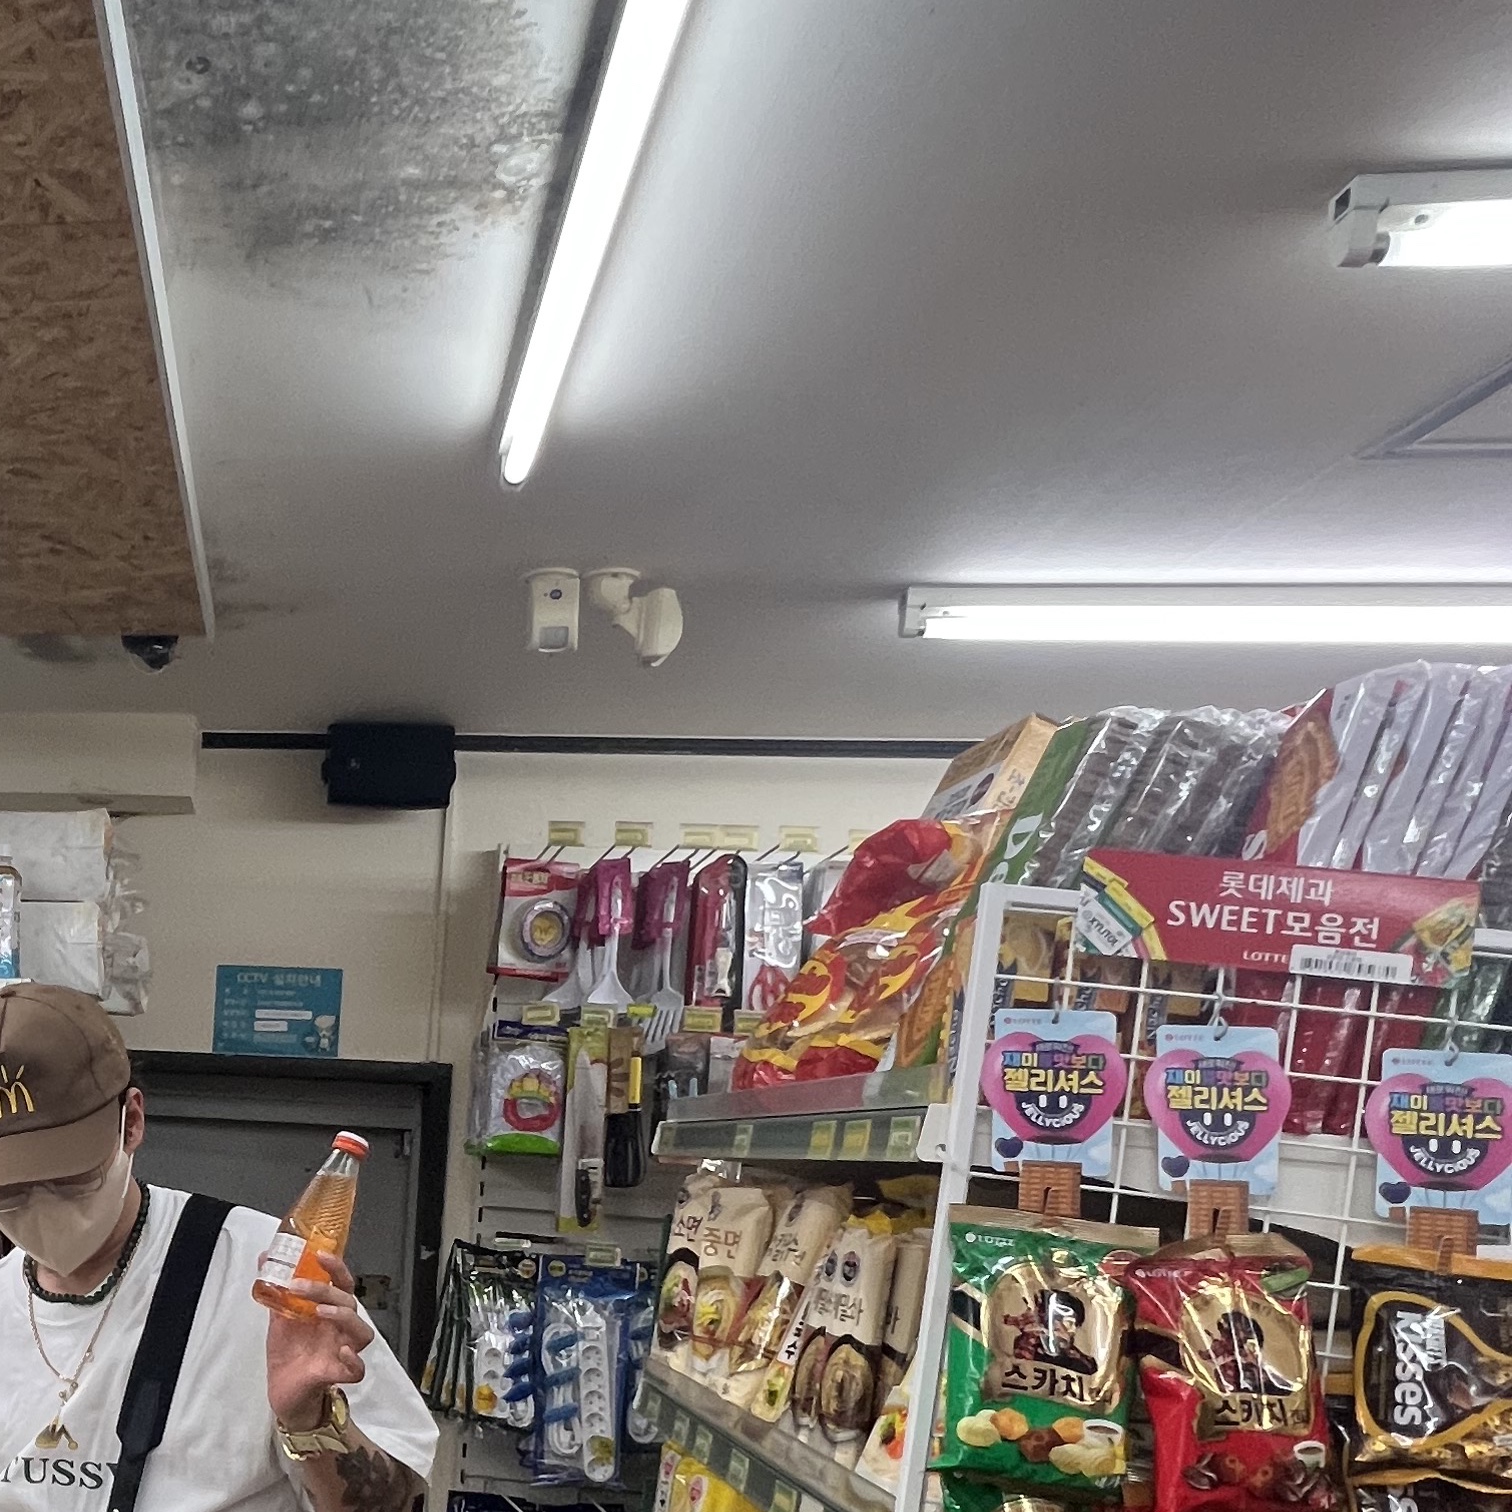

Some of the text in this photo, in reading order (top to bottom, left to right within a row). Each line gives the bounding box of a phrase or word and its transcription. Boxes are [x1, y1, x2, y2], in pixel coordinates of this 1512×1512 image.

[1219, 870, 1335, 907] 롯데제과
[1003, 1067, 1104, 1095] 젤리셔스
[1167, 1085, 1268, 1112] 젤리셔스
[1021, 1102, 1085, 1129] JELLYCIOUS
[1391, 1109, 1502, 1139] 젤리셔스
[1185, 1119, 1251, 1148] JELLYCIOUS
[1409, 1145, 1481, 1174] JELLYCIOUS
[702, 1226, 742, 1259] 중면
[1002, 1363, 1084, 1402] 스카치
[1214, 1398, 1285, 1429] 스카치
